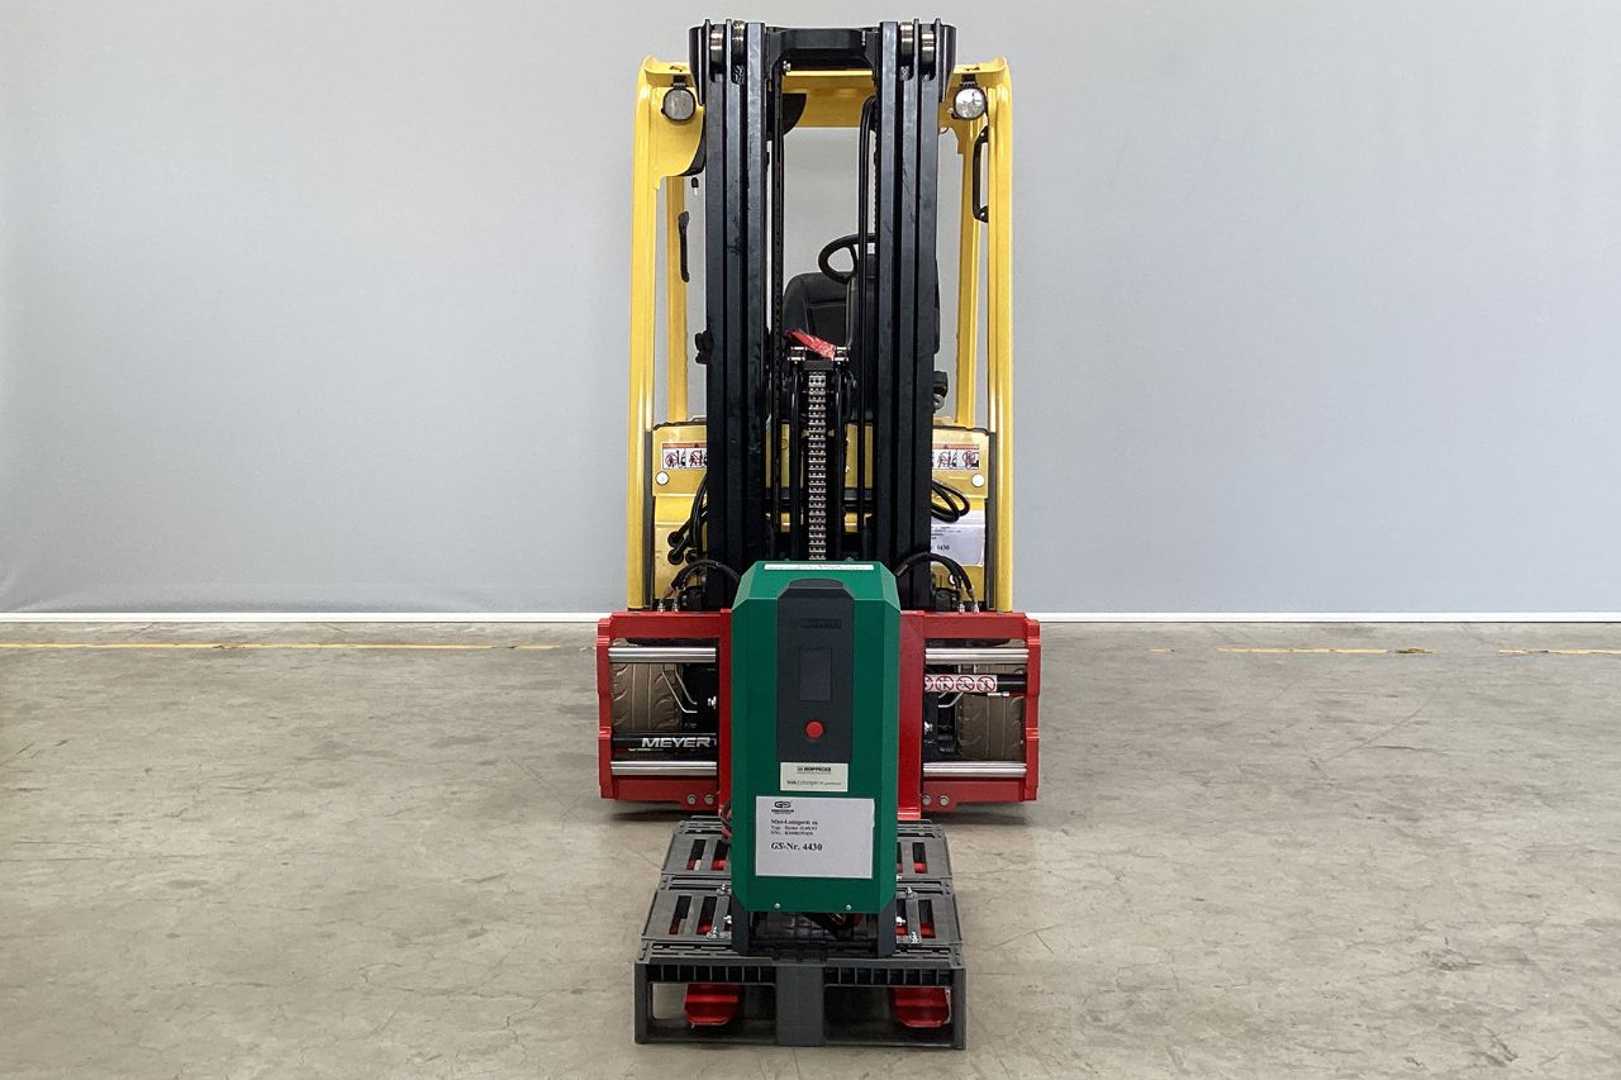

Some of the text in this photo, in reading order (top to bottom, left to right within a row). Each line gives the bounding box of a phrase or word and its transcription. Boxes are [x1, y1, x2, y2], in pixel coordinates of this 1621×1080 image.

[641, 737, 711, 748] MEYER
[770, 842, 823, 851] GS-Nr. 4430
